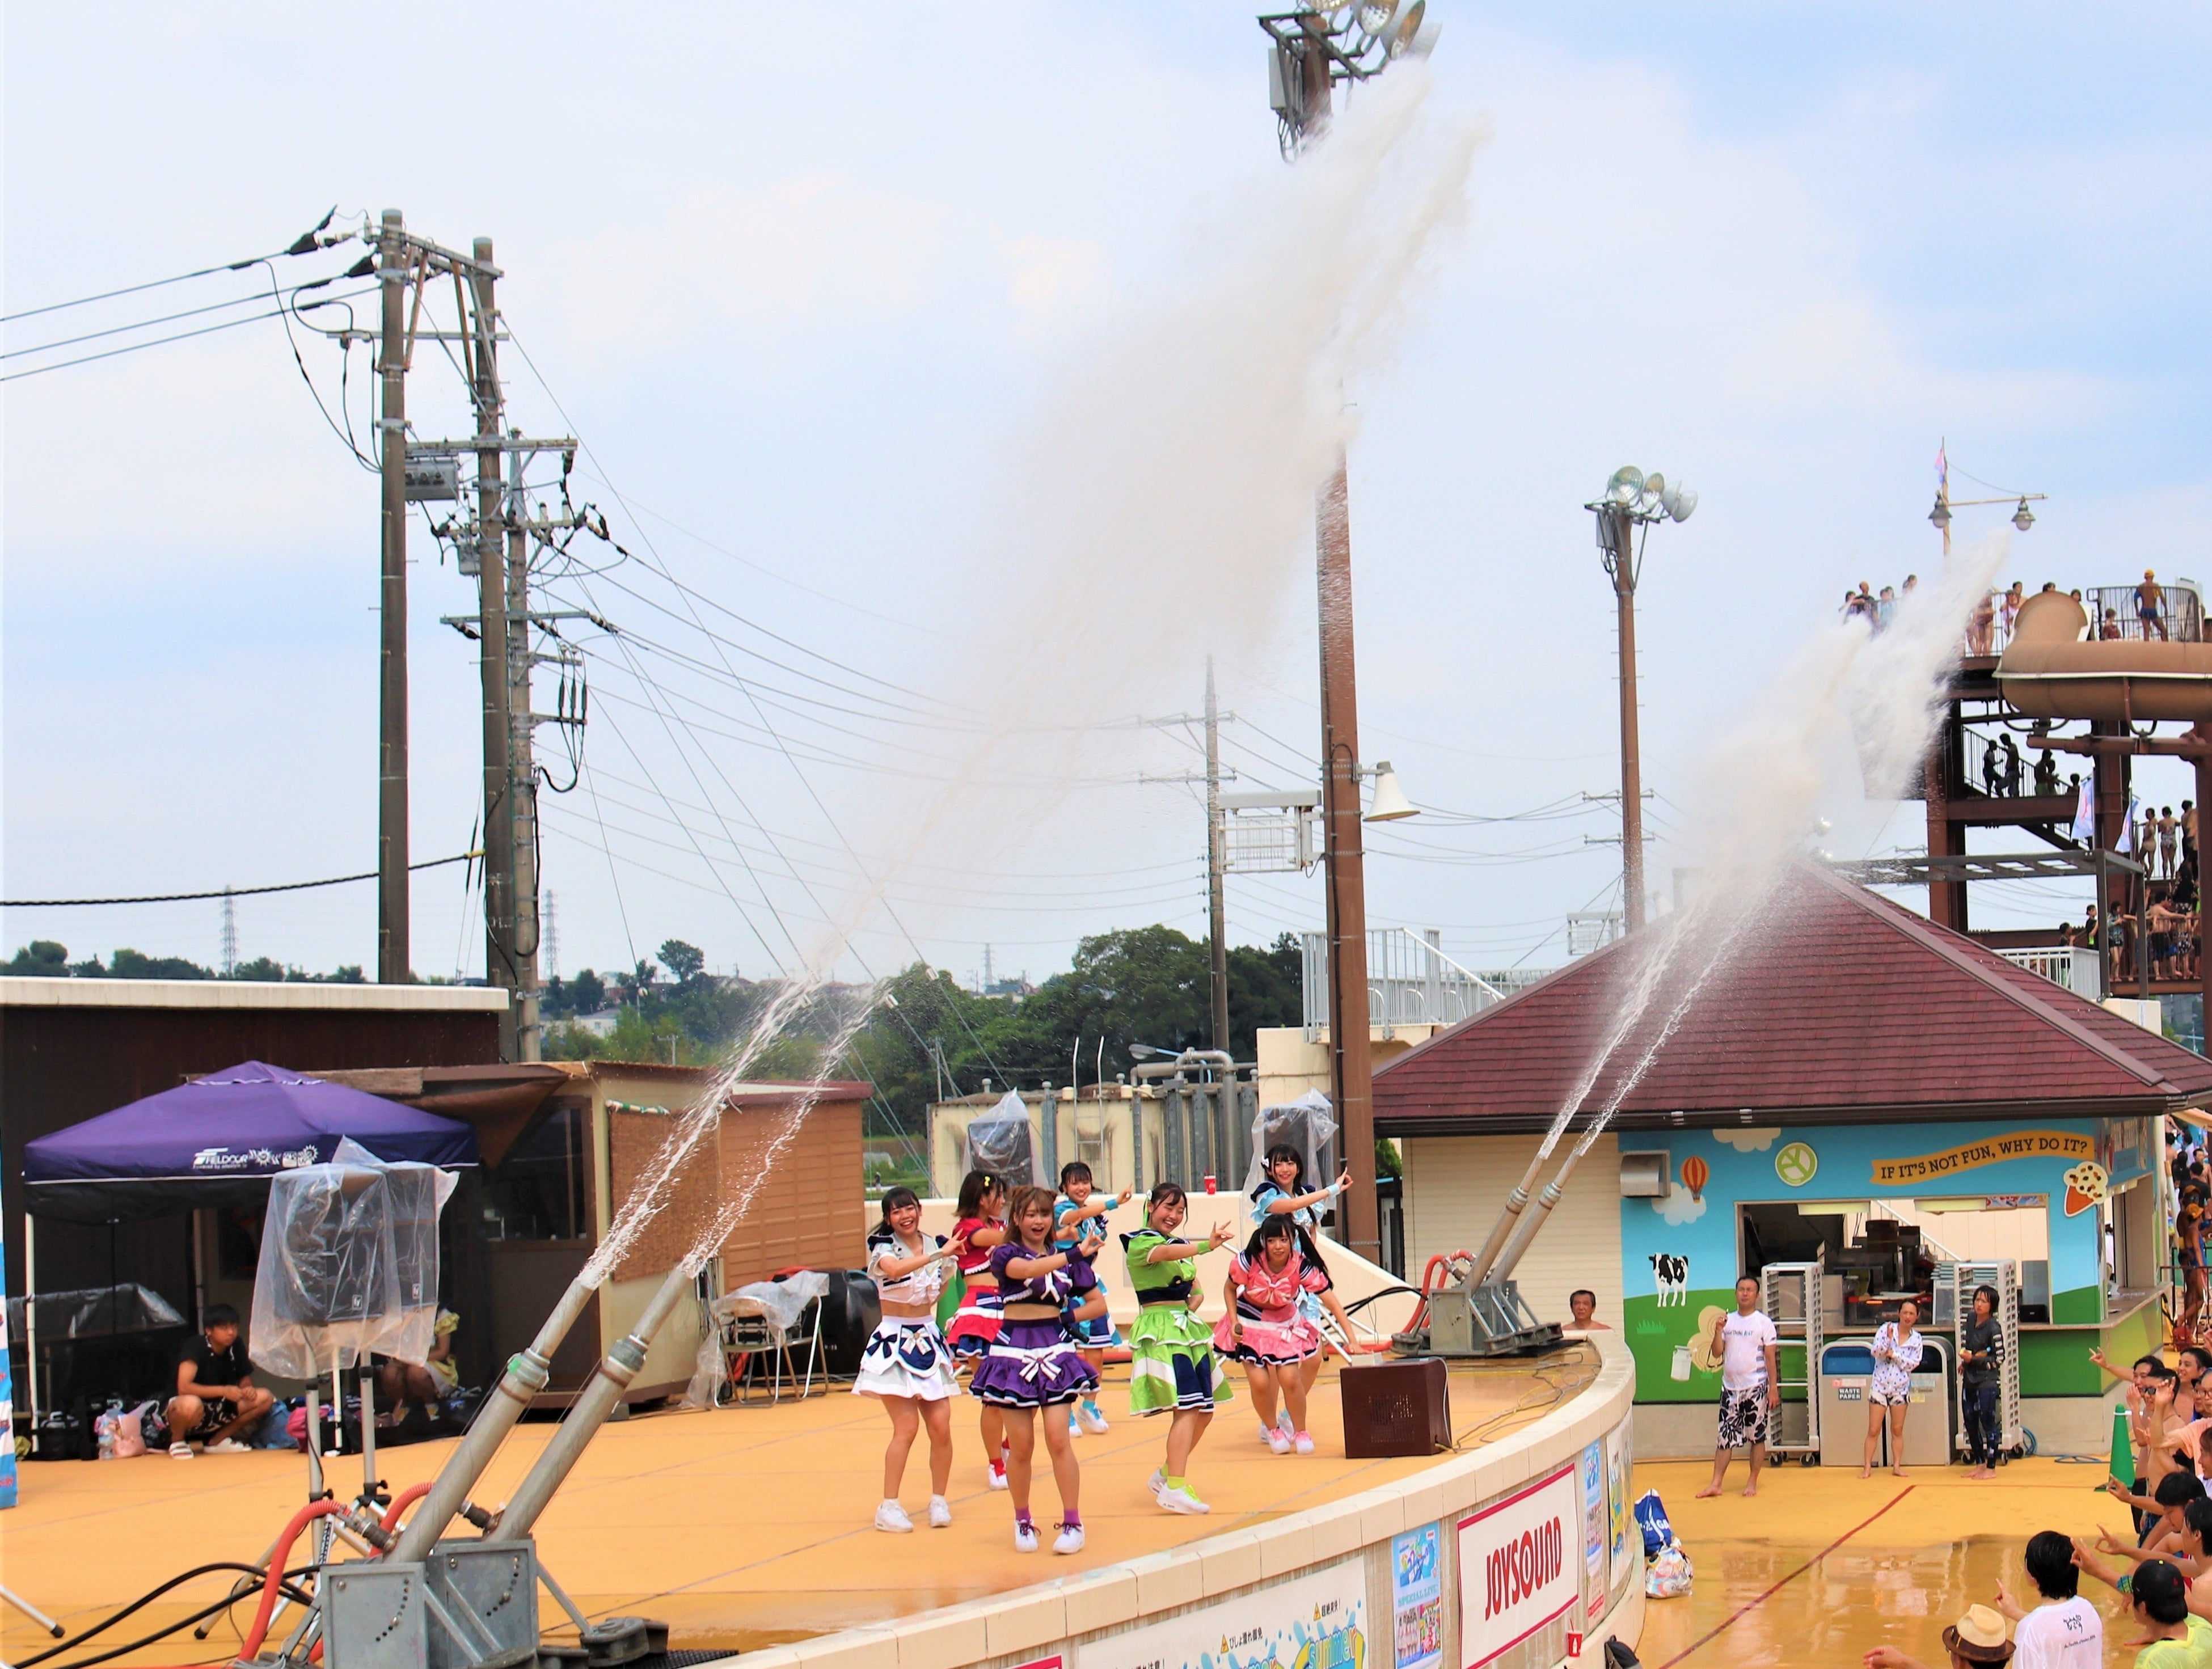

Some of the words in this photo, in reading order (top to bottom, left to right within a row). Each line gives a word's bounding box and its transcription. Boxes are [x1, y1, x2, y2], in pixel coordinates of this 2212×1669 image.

[1881, 1167, 1894, 1179] IF
[1898, 1162, 1926, 1178] IT'S
[1929, 1155, 1958, 1172] NOT
[1962, 1145, 1996, 1165] FUN,
[1998, 1138, 2034, 1155] WHY
[2039, 1138, 2059, 1150] DO
[2063, 1138, 2087, 1153] IT?
[1485, 1515, 1562, 1621] JOYSOUND
